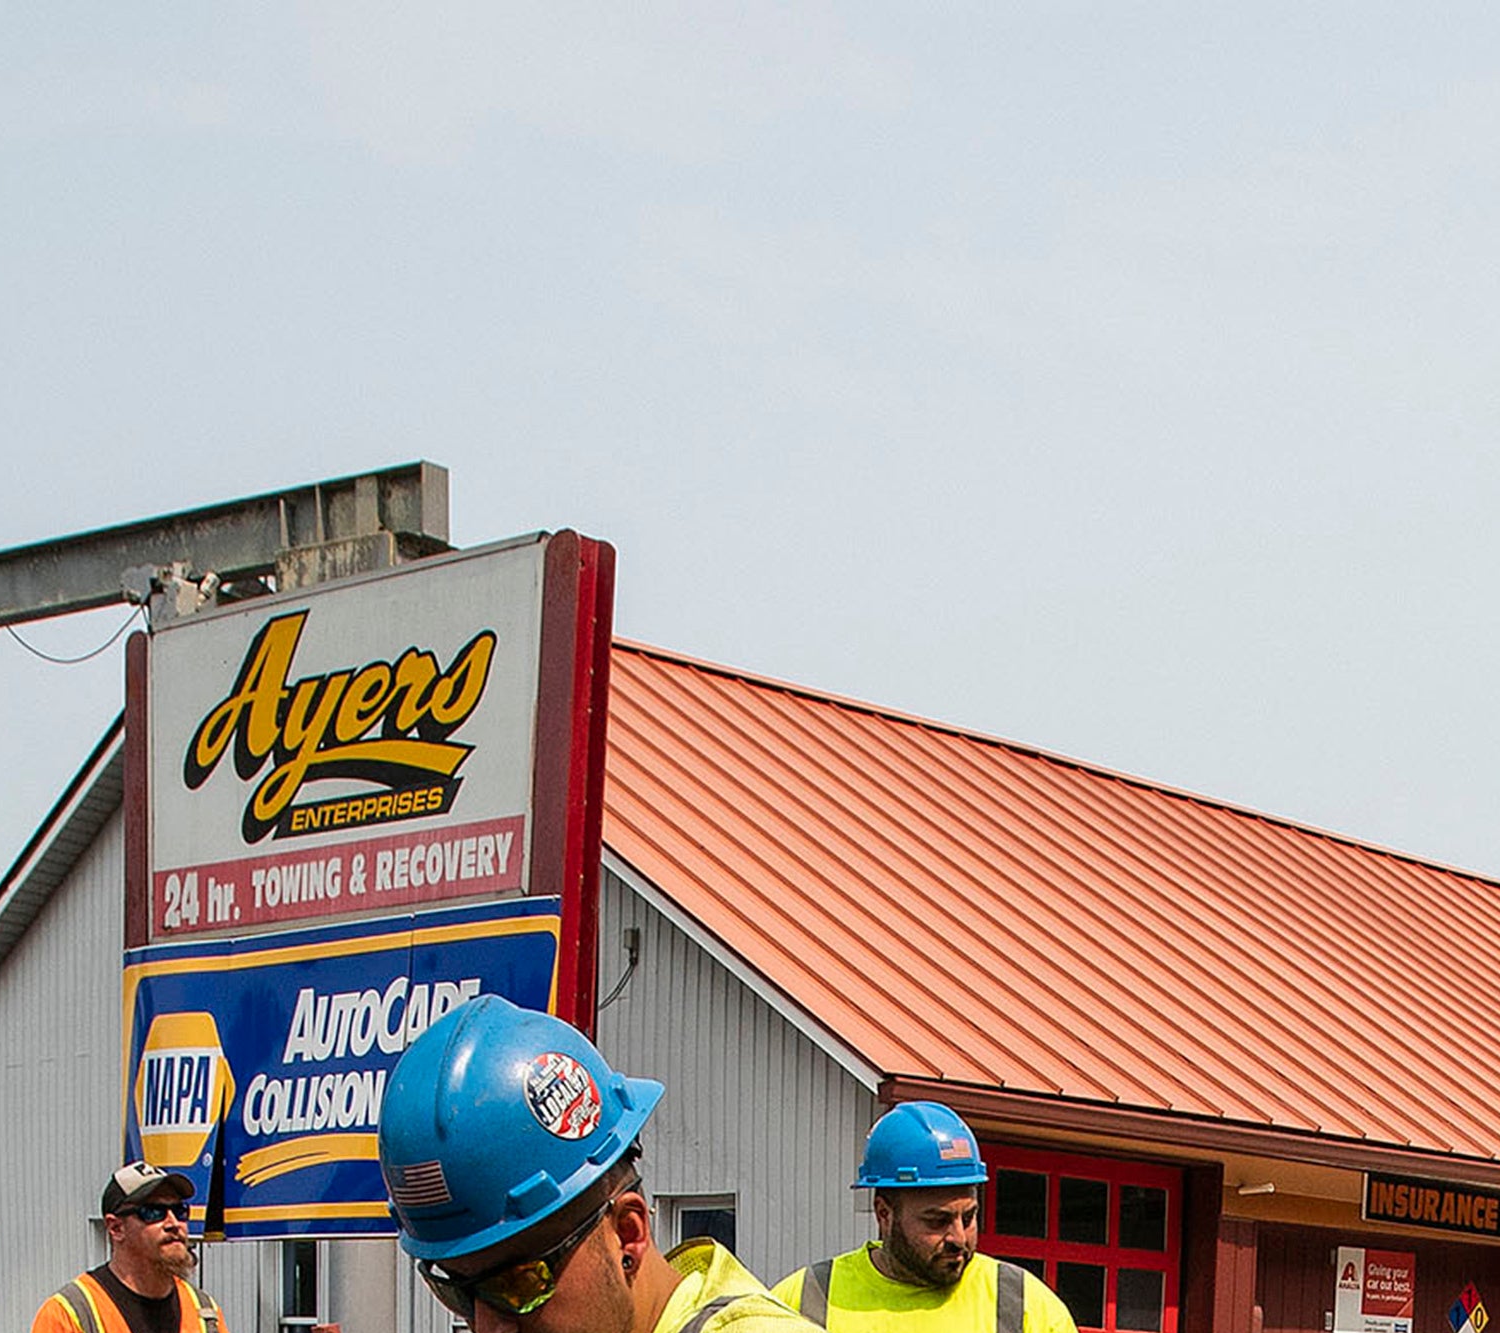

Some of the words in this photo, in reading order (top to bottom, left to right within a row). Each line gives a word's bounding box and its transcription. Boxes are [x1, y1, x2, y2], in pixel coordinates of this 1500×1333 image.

[184, 609, 497, 844] Ayers
[290, 786, 444, 832] ENTERPRISES
[164, 872, 201, 928] 24
[206, 878, 241, 922] hr.
[251, 856, 342, 909] TOWING
[348, 853, 367, 895] &
[374, 831, 515, 892] RECOVERY
[144, 1055, 211, 1128] NAPA
[243, 1070, 387, 1136] COLLISION
[1370, 1181, 1500, 1231] INSURANCE
